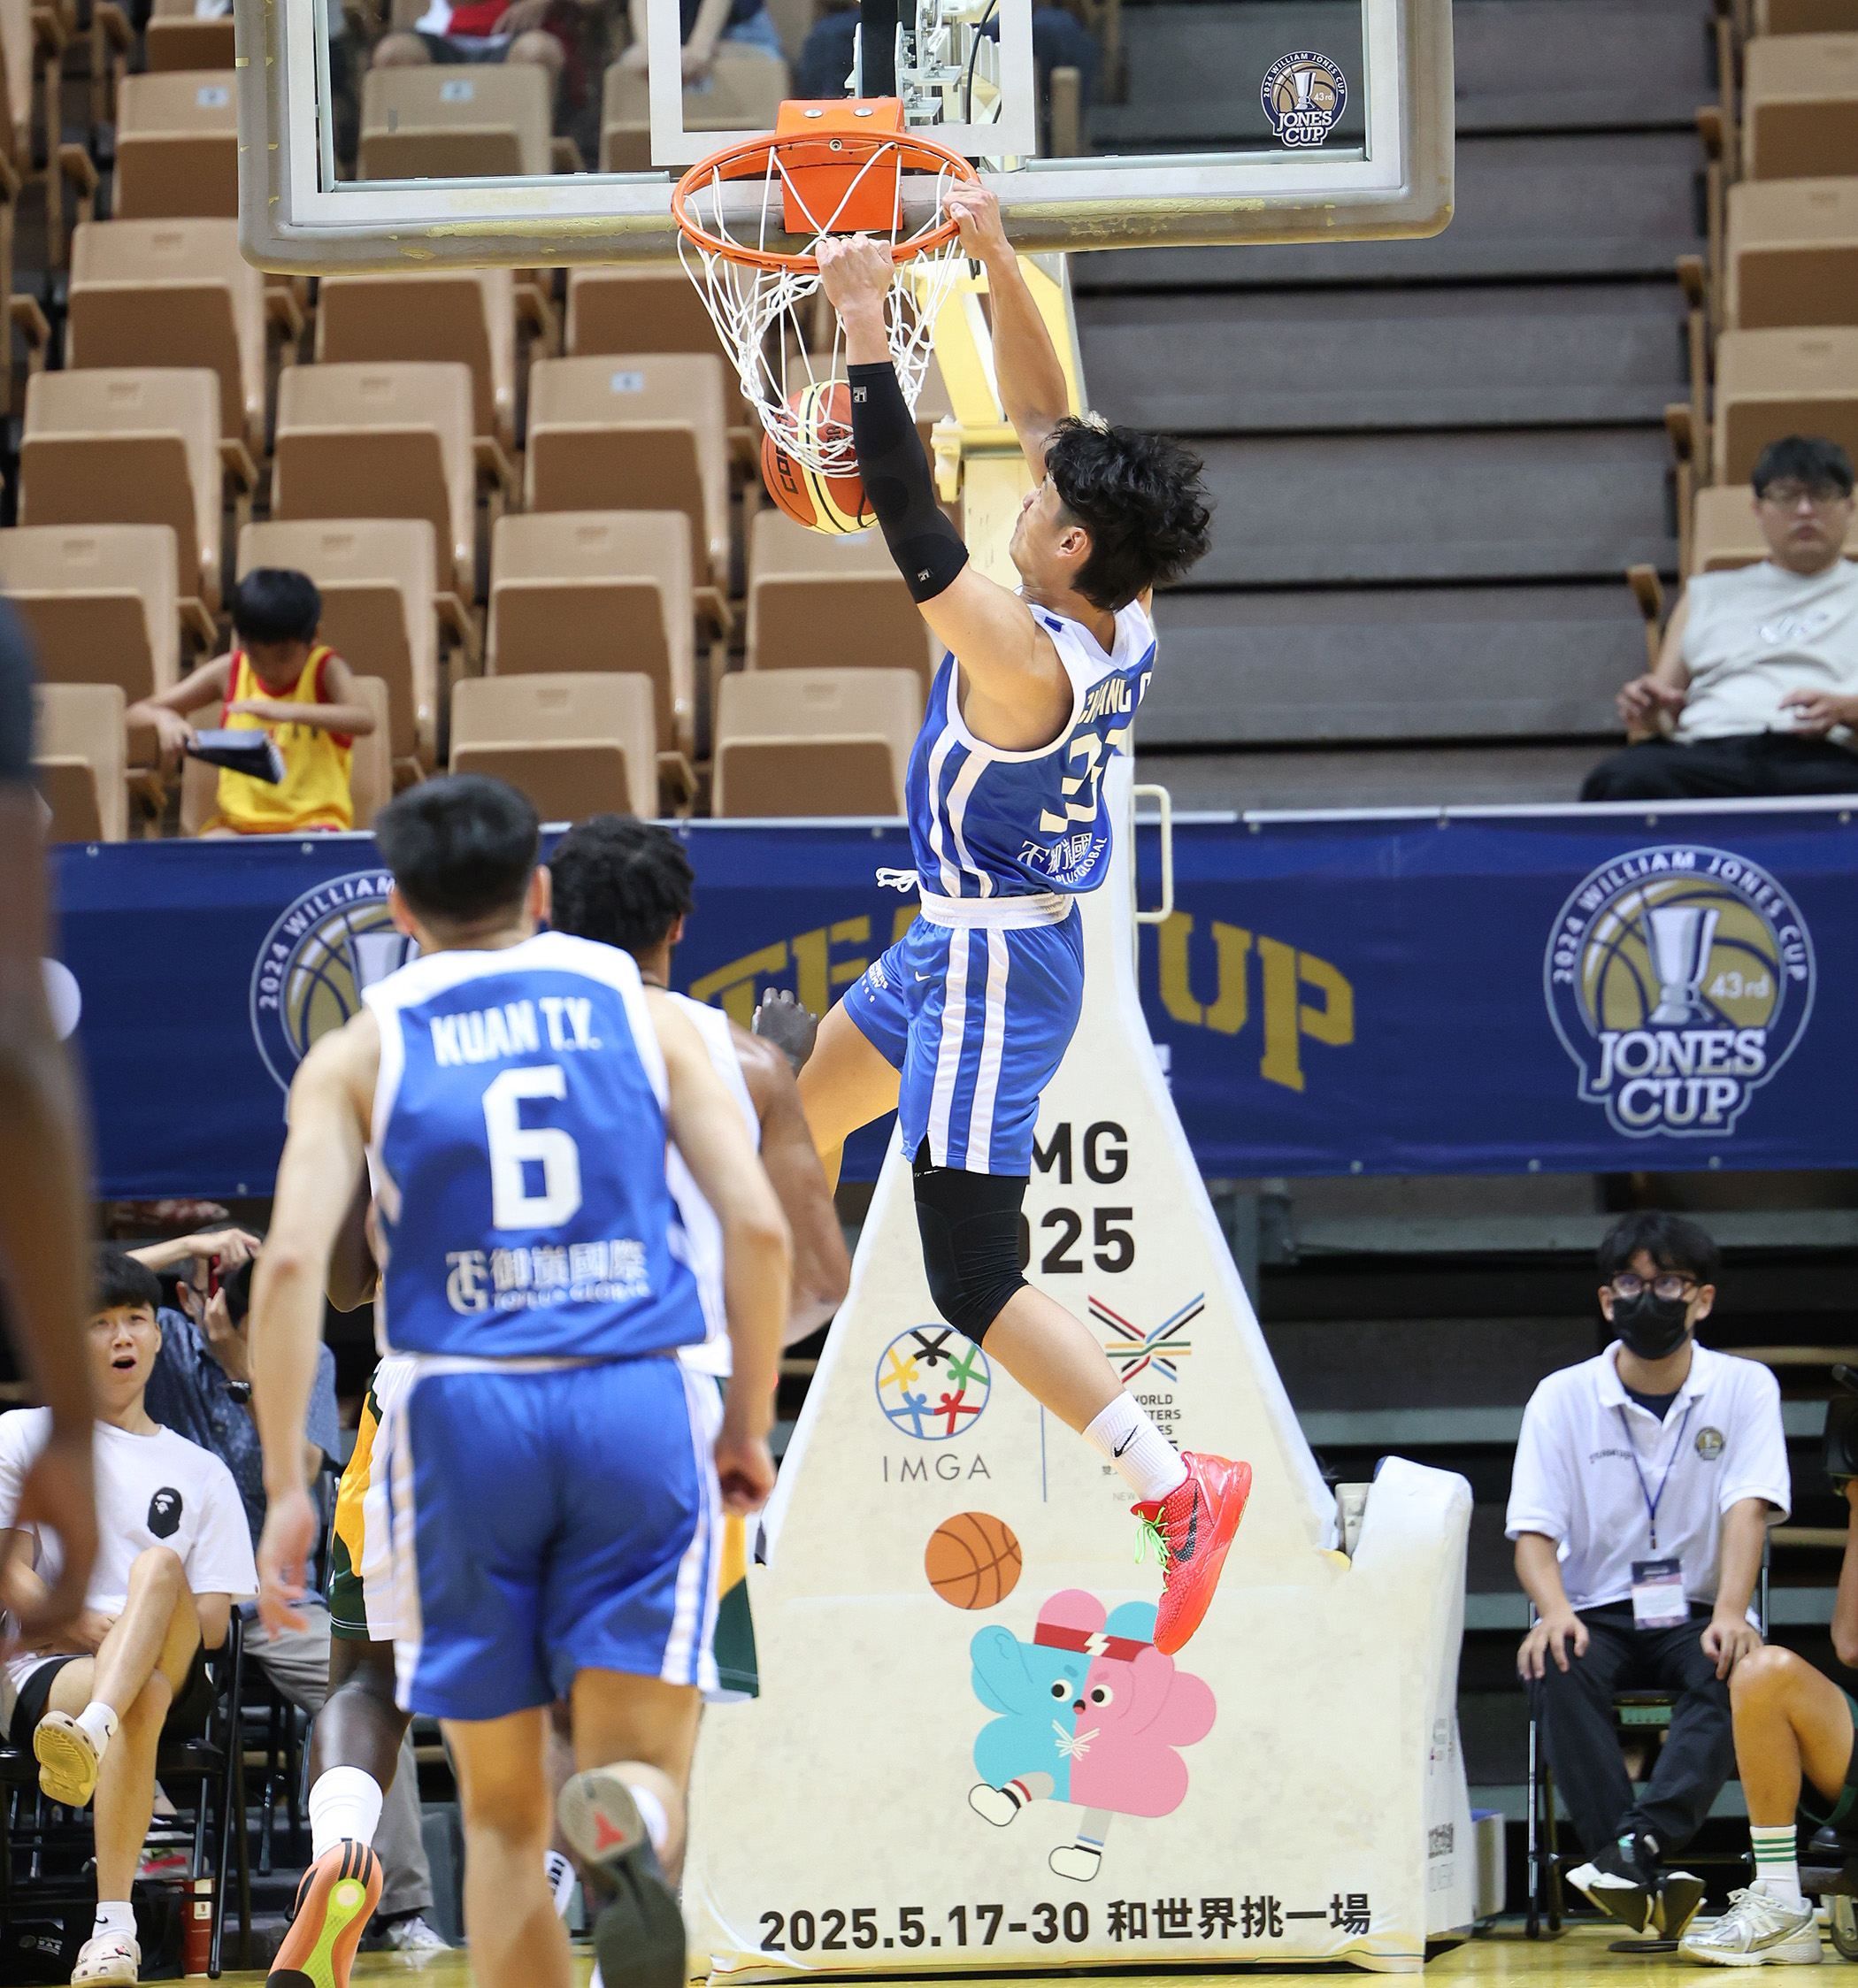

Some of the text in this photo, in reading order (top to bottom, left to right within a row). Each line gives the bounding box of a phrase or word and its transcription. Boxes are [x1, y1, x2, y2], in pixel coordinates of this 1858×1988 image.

[1263, 53, 1345, 97] 2024 WILLIAM JONES CUP
[1314, 92, 1333, 102] 43rd
[1277, 110, 1332, 132] JONES
[1285, 127, 1324, 142] CUP
[1553, 851, 1808, 984] 2024 WILLIAM JONES CUP
[258, 875, 395, 1009] 2024 WILLIAM
[1709, 971, 1770, 999] 43rd
[429, 996, 603, 1067] KUAN T.Y.
[1592, 1028, 1767, 1091] JONES
[1617, 1077, 1739, 1125] CUP
[481, 1064, 583, 1232] 6
[1144, 1408, 1181, 1421] TERS
[883, 1453, 991, 1482] IMGA
[759, 1893, 1370, 1952] 2025.5.17-30 和世界挑一場
